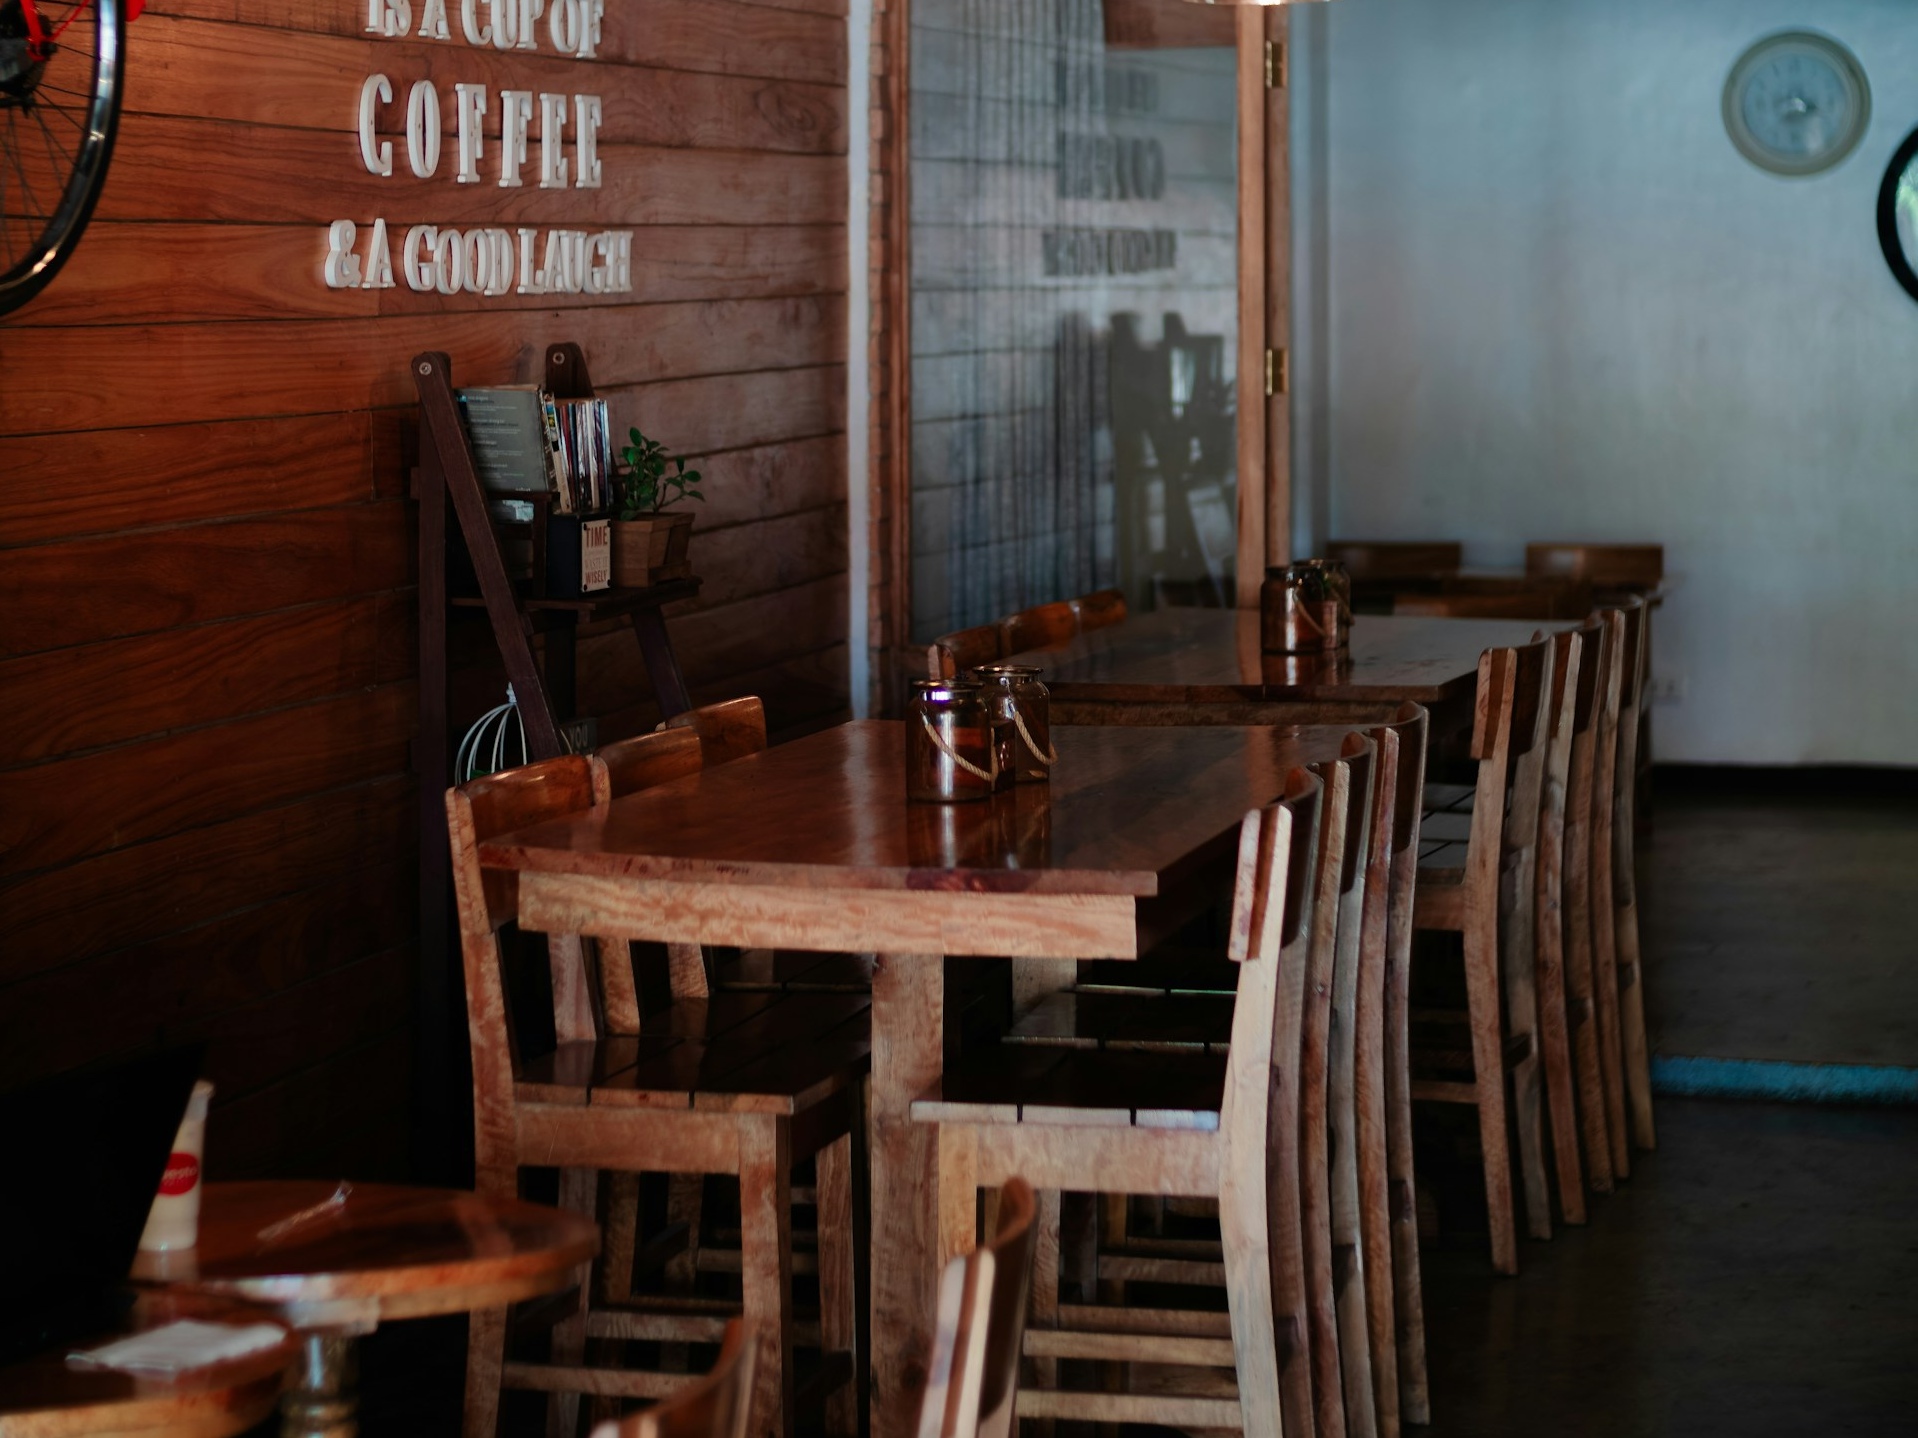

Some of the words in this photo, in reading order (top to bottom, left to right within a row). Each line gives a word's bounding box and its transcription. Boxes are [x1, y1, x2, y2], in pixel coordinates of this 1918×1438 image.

[418, 0, 451, 39] A
[461, 0, 544, 50] CUP
[550, 0, 604, 58] OF
[358, 73, 602, 189] COFFEE
[324, 219, 361, 288] &
[362, 218, 396, 289] A
[403, 225, 514, 296] GOOD
[517, 228, 634, 295] LAUGH
[586, 525, 607, 547] TIME
[586, 569, 607, 584] WISELY
[569, 724, 588, 749] YOU
